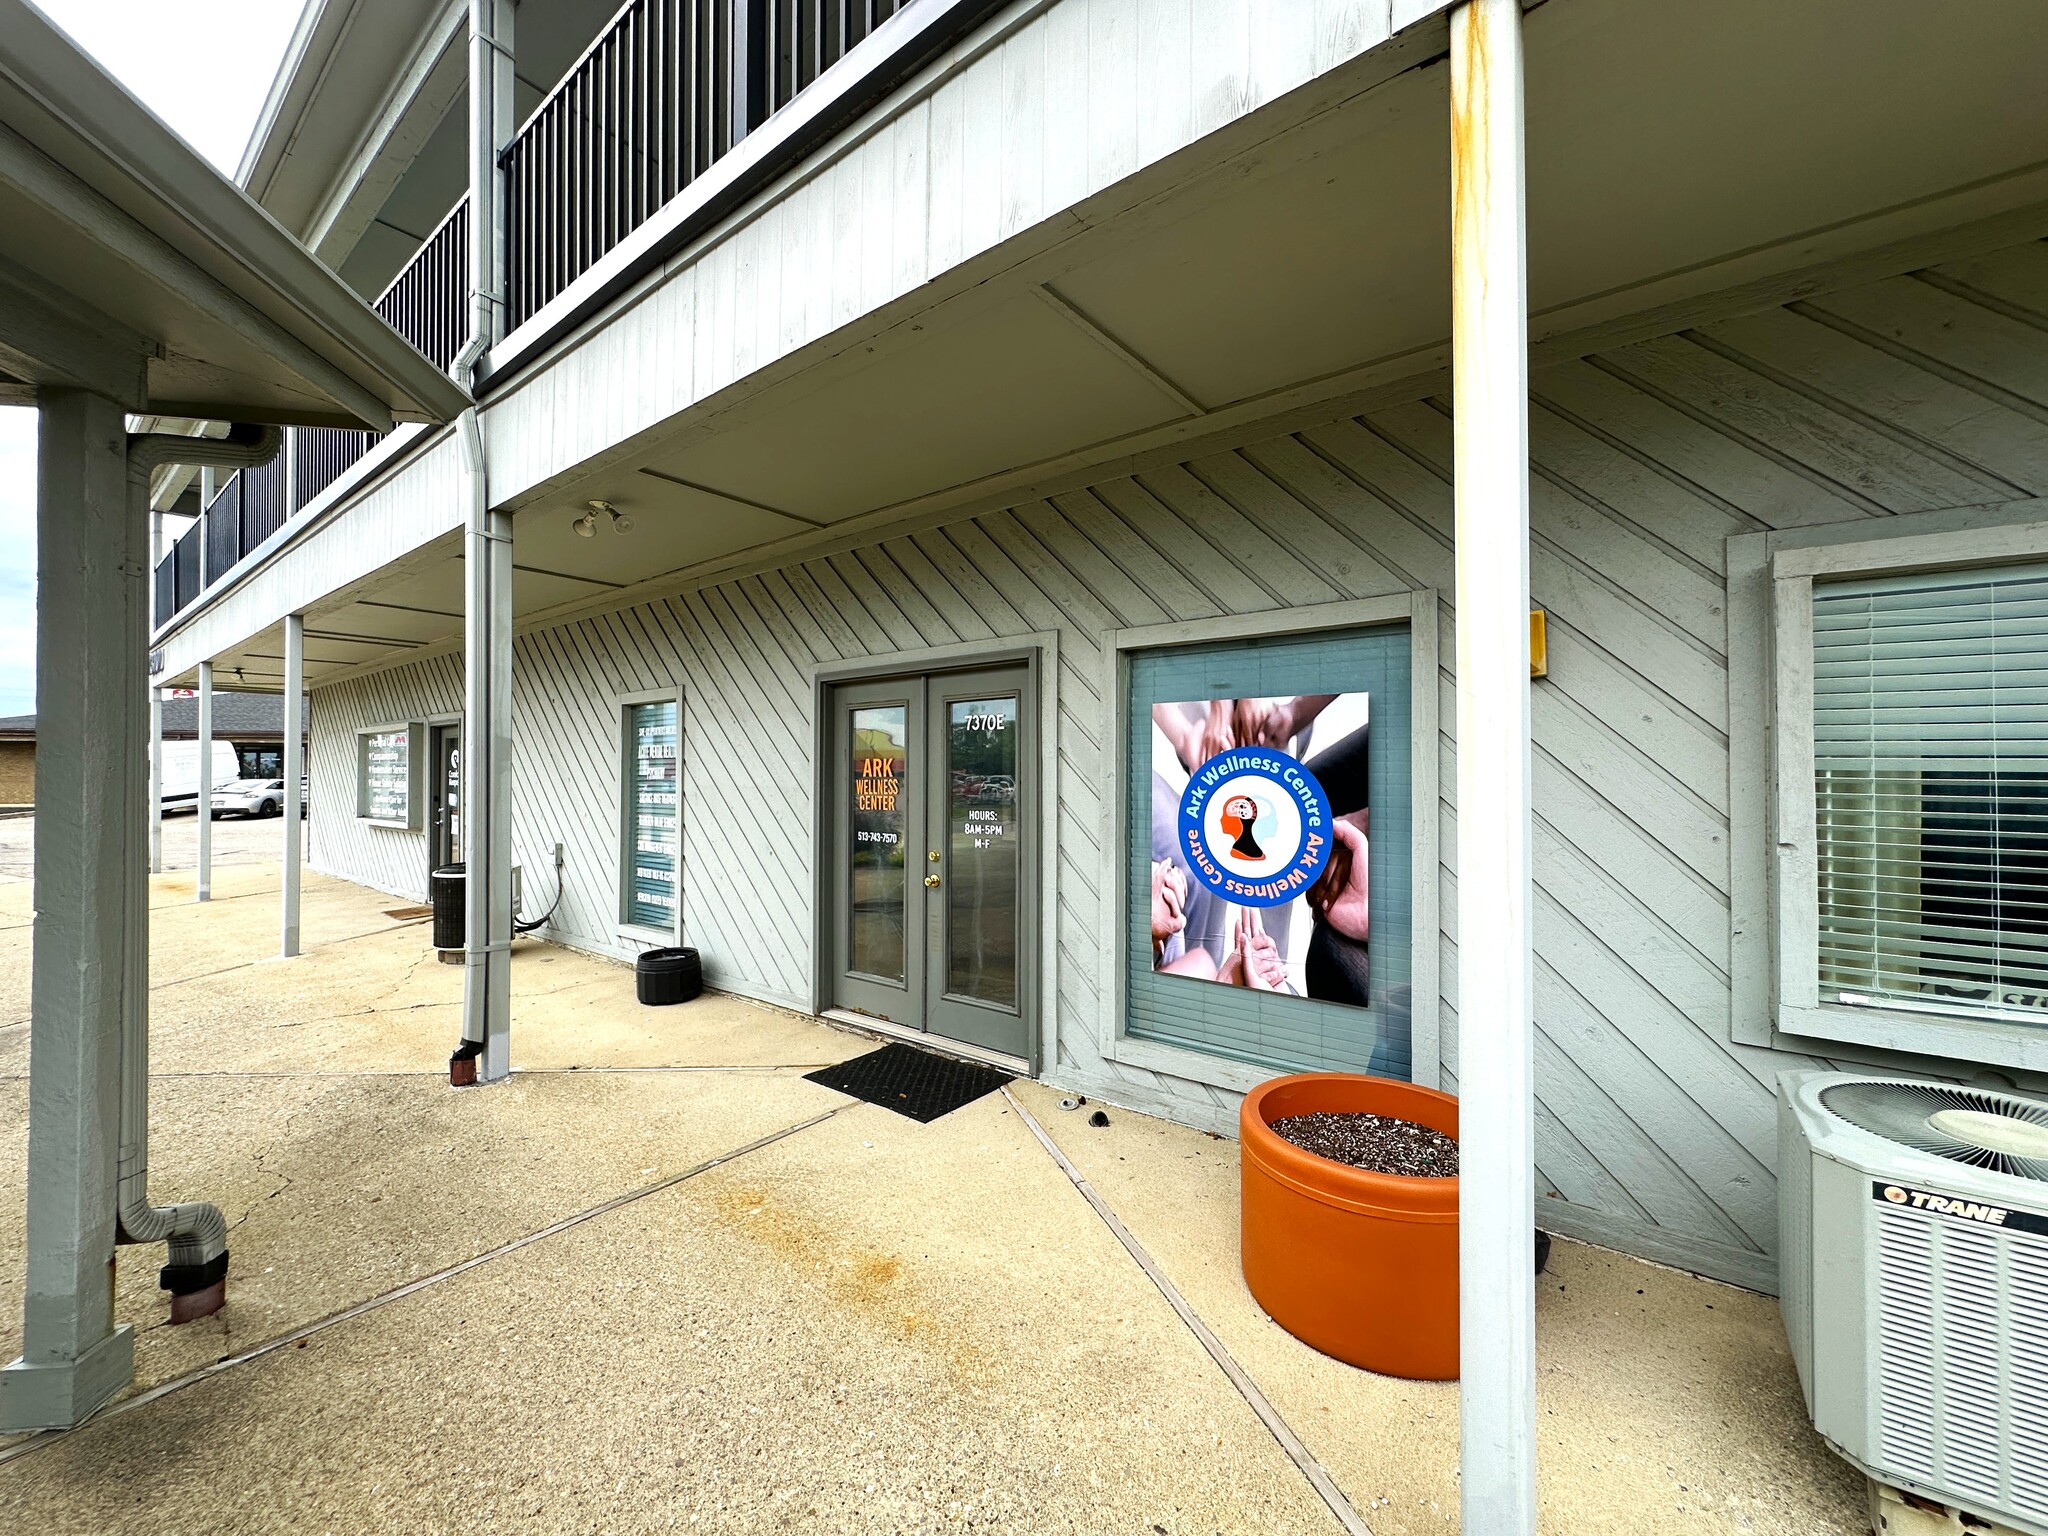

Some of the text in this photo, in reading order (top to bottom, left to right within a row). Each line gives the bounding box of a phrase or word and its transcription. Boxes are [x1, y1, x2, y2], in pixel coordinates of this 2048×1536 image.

[965, 713, 1005, 731] 7370E
[863, 758, 893, 777] ARK
[856, 779, 900, 796] WELLNESS
[1186, 755, 1322, 827] Ark Wellness Centre
[859, 795, 895, 811] CENTER
[969, 810, 998, 822] HOURS:
[857, 831, 898, 844] 513-743-7570
[964, 823, 1003, 836] 8AM-5PM
[974, 838, 991, 848] M-F
[1188, 829, 1325, 900] Ark Wellness Centre
[1910, 1191, 2008, 1225] TRANE
